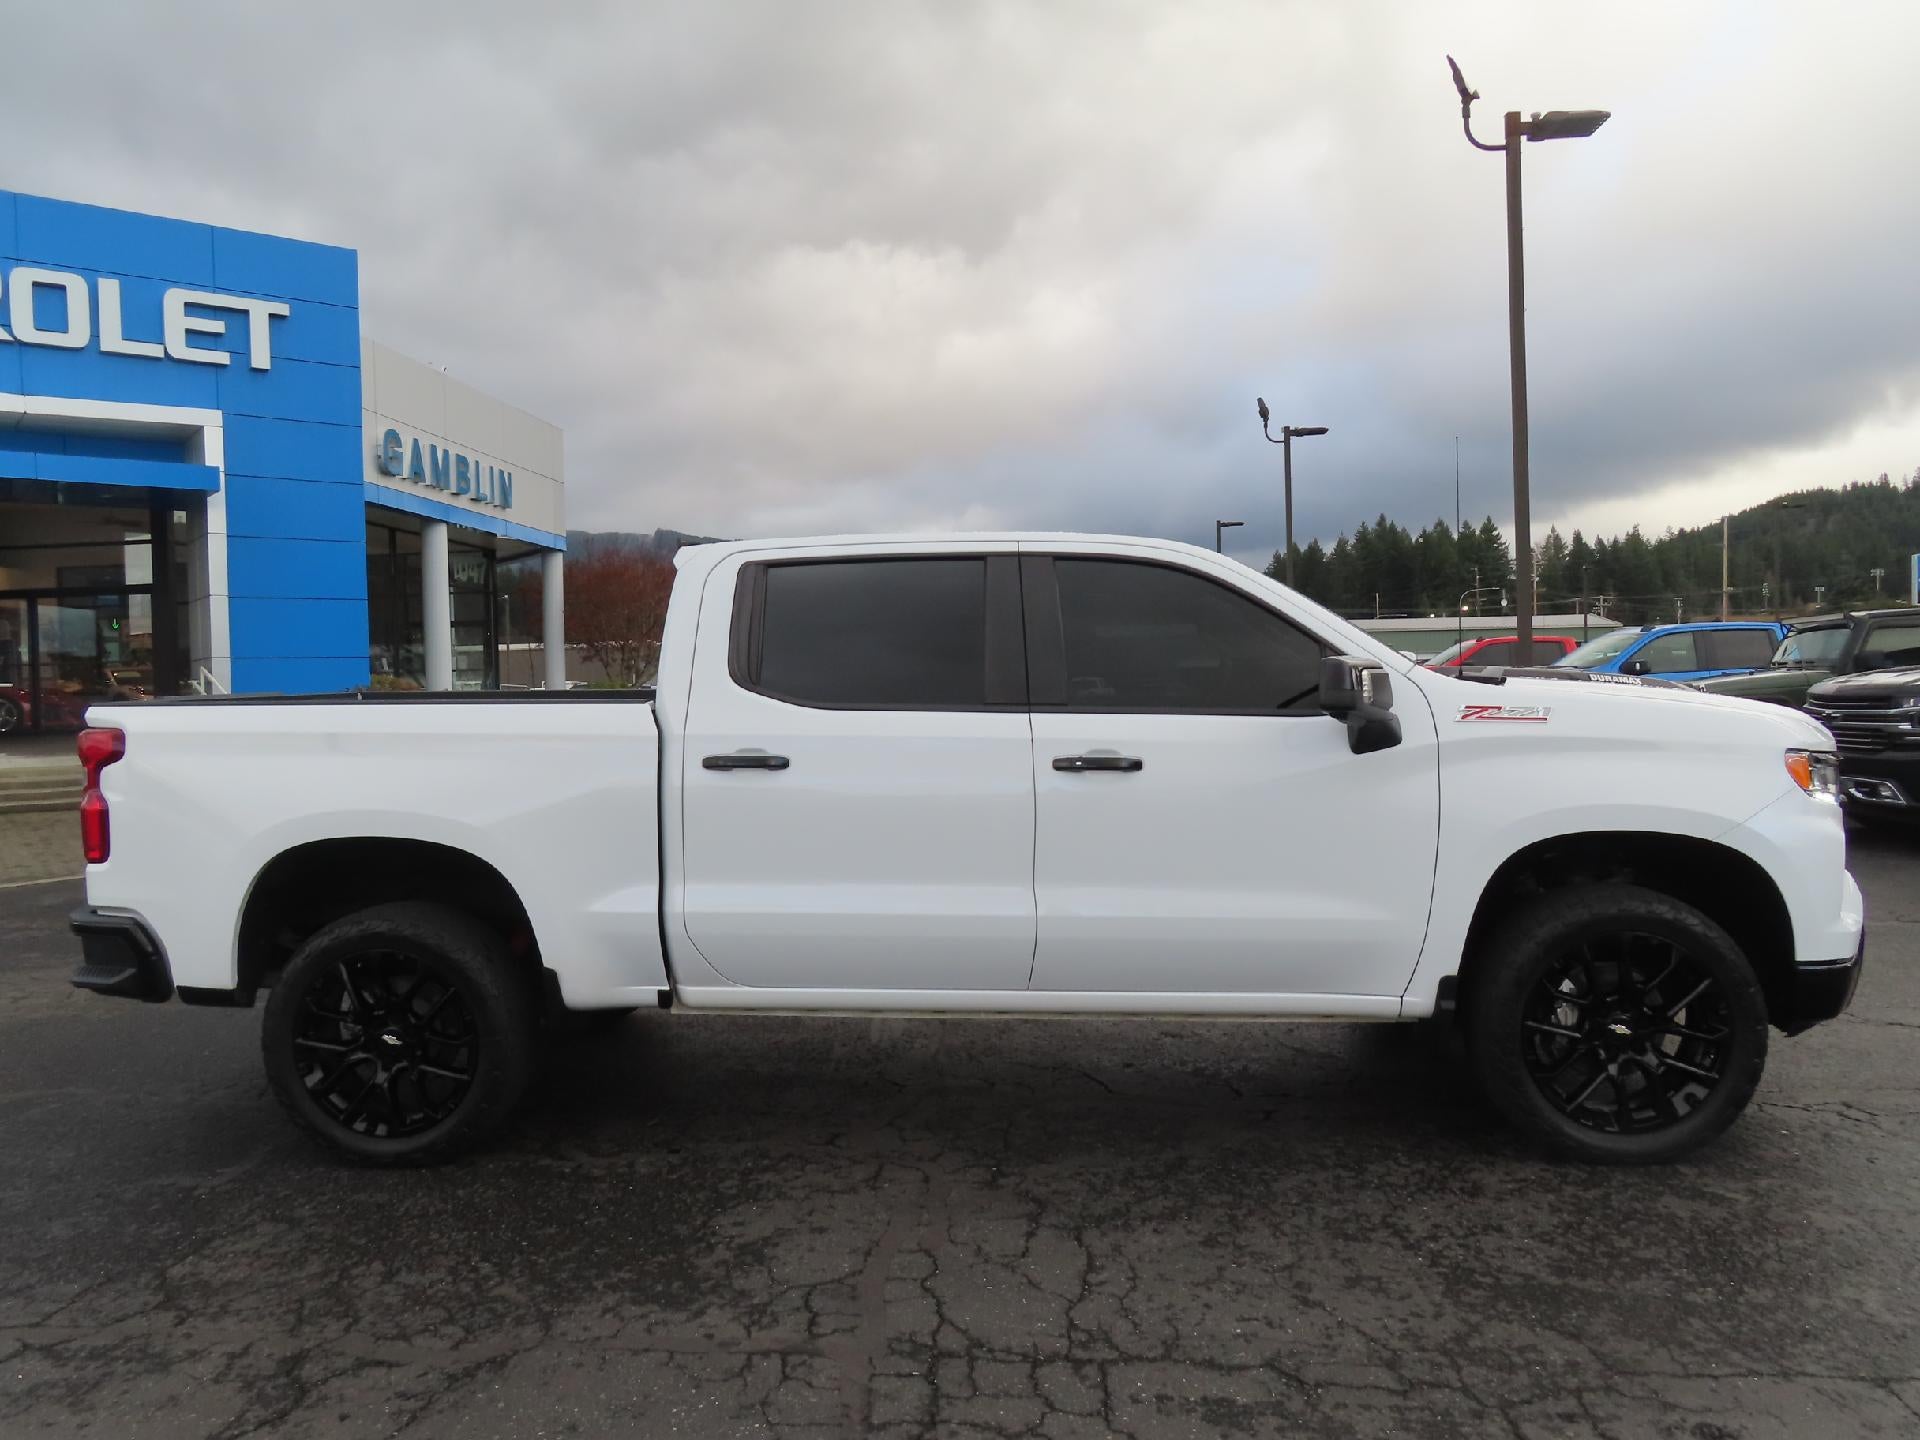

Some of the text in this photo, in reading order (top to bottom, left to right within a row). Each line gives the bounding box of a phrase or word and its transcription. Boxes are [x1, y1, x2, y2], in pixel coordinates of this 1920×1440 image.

[0, 267, 290, 370] OLET
[380, 428, 513, 510] GAMBLIN
[1589, 673, 1642, 685] DURAMAX
[1456, 705, 1551, 724] Z71
